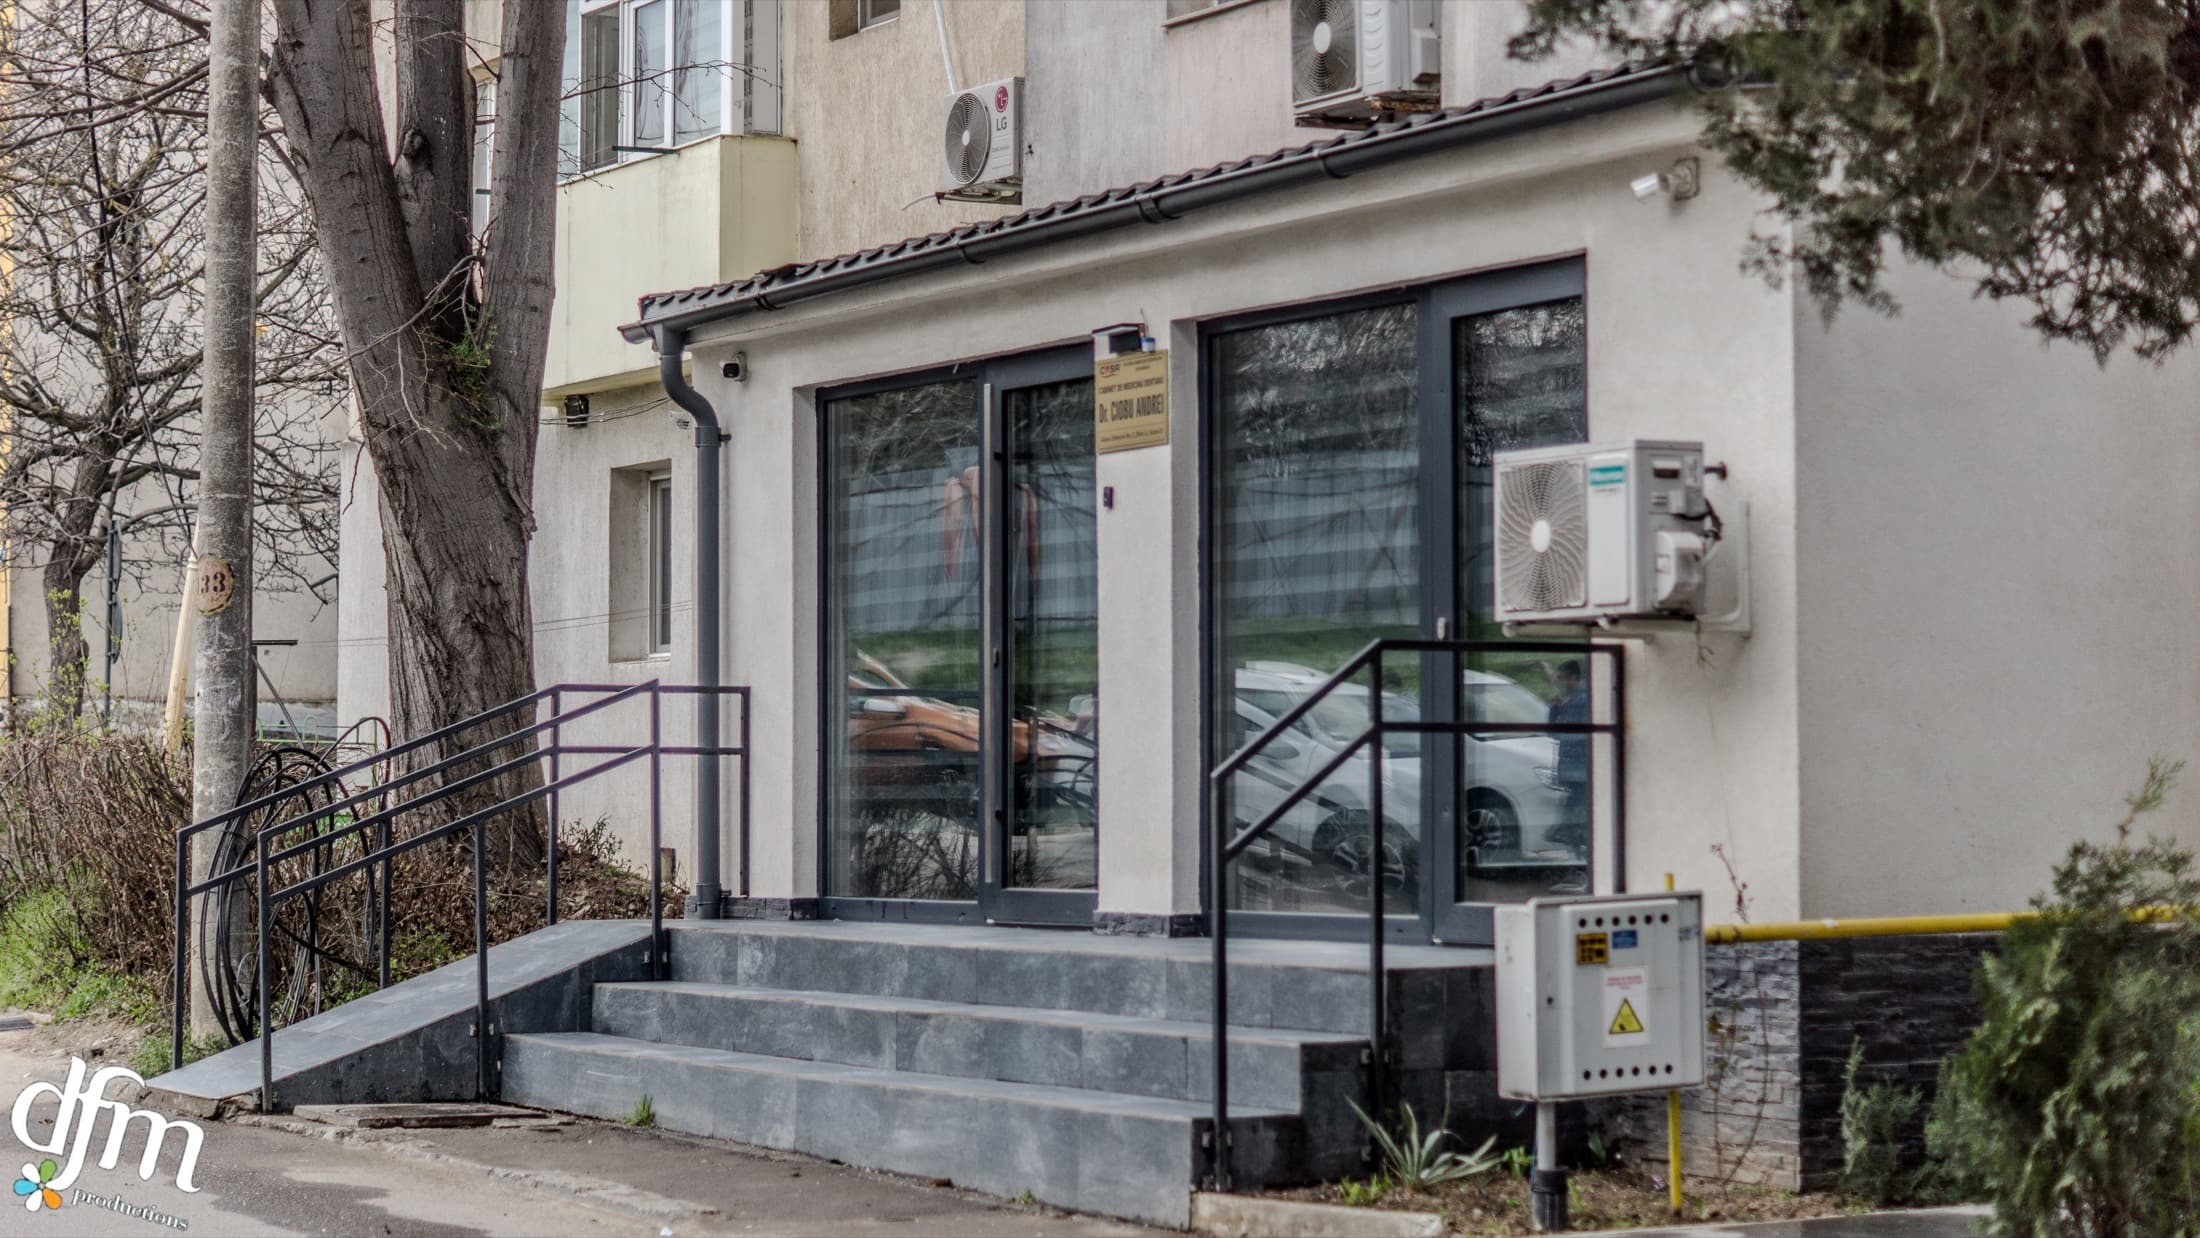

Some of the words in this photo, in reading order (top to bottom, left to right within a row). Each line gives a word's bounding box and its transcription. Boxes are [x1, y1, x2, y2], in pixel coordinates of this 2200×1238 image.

[995, 116, 1008, 131] LG
[1111, 398, 1134, 422] CIOBU
[1135, 393, 1164, 418] ANDREI
